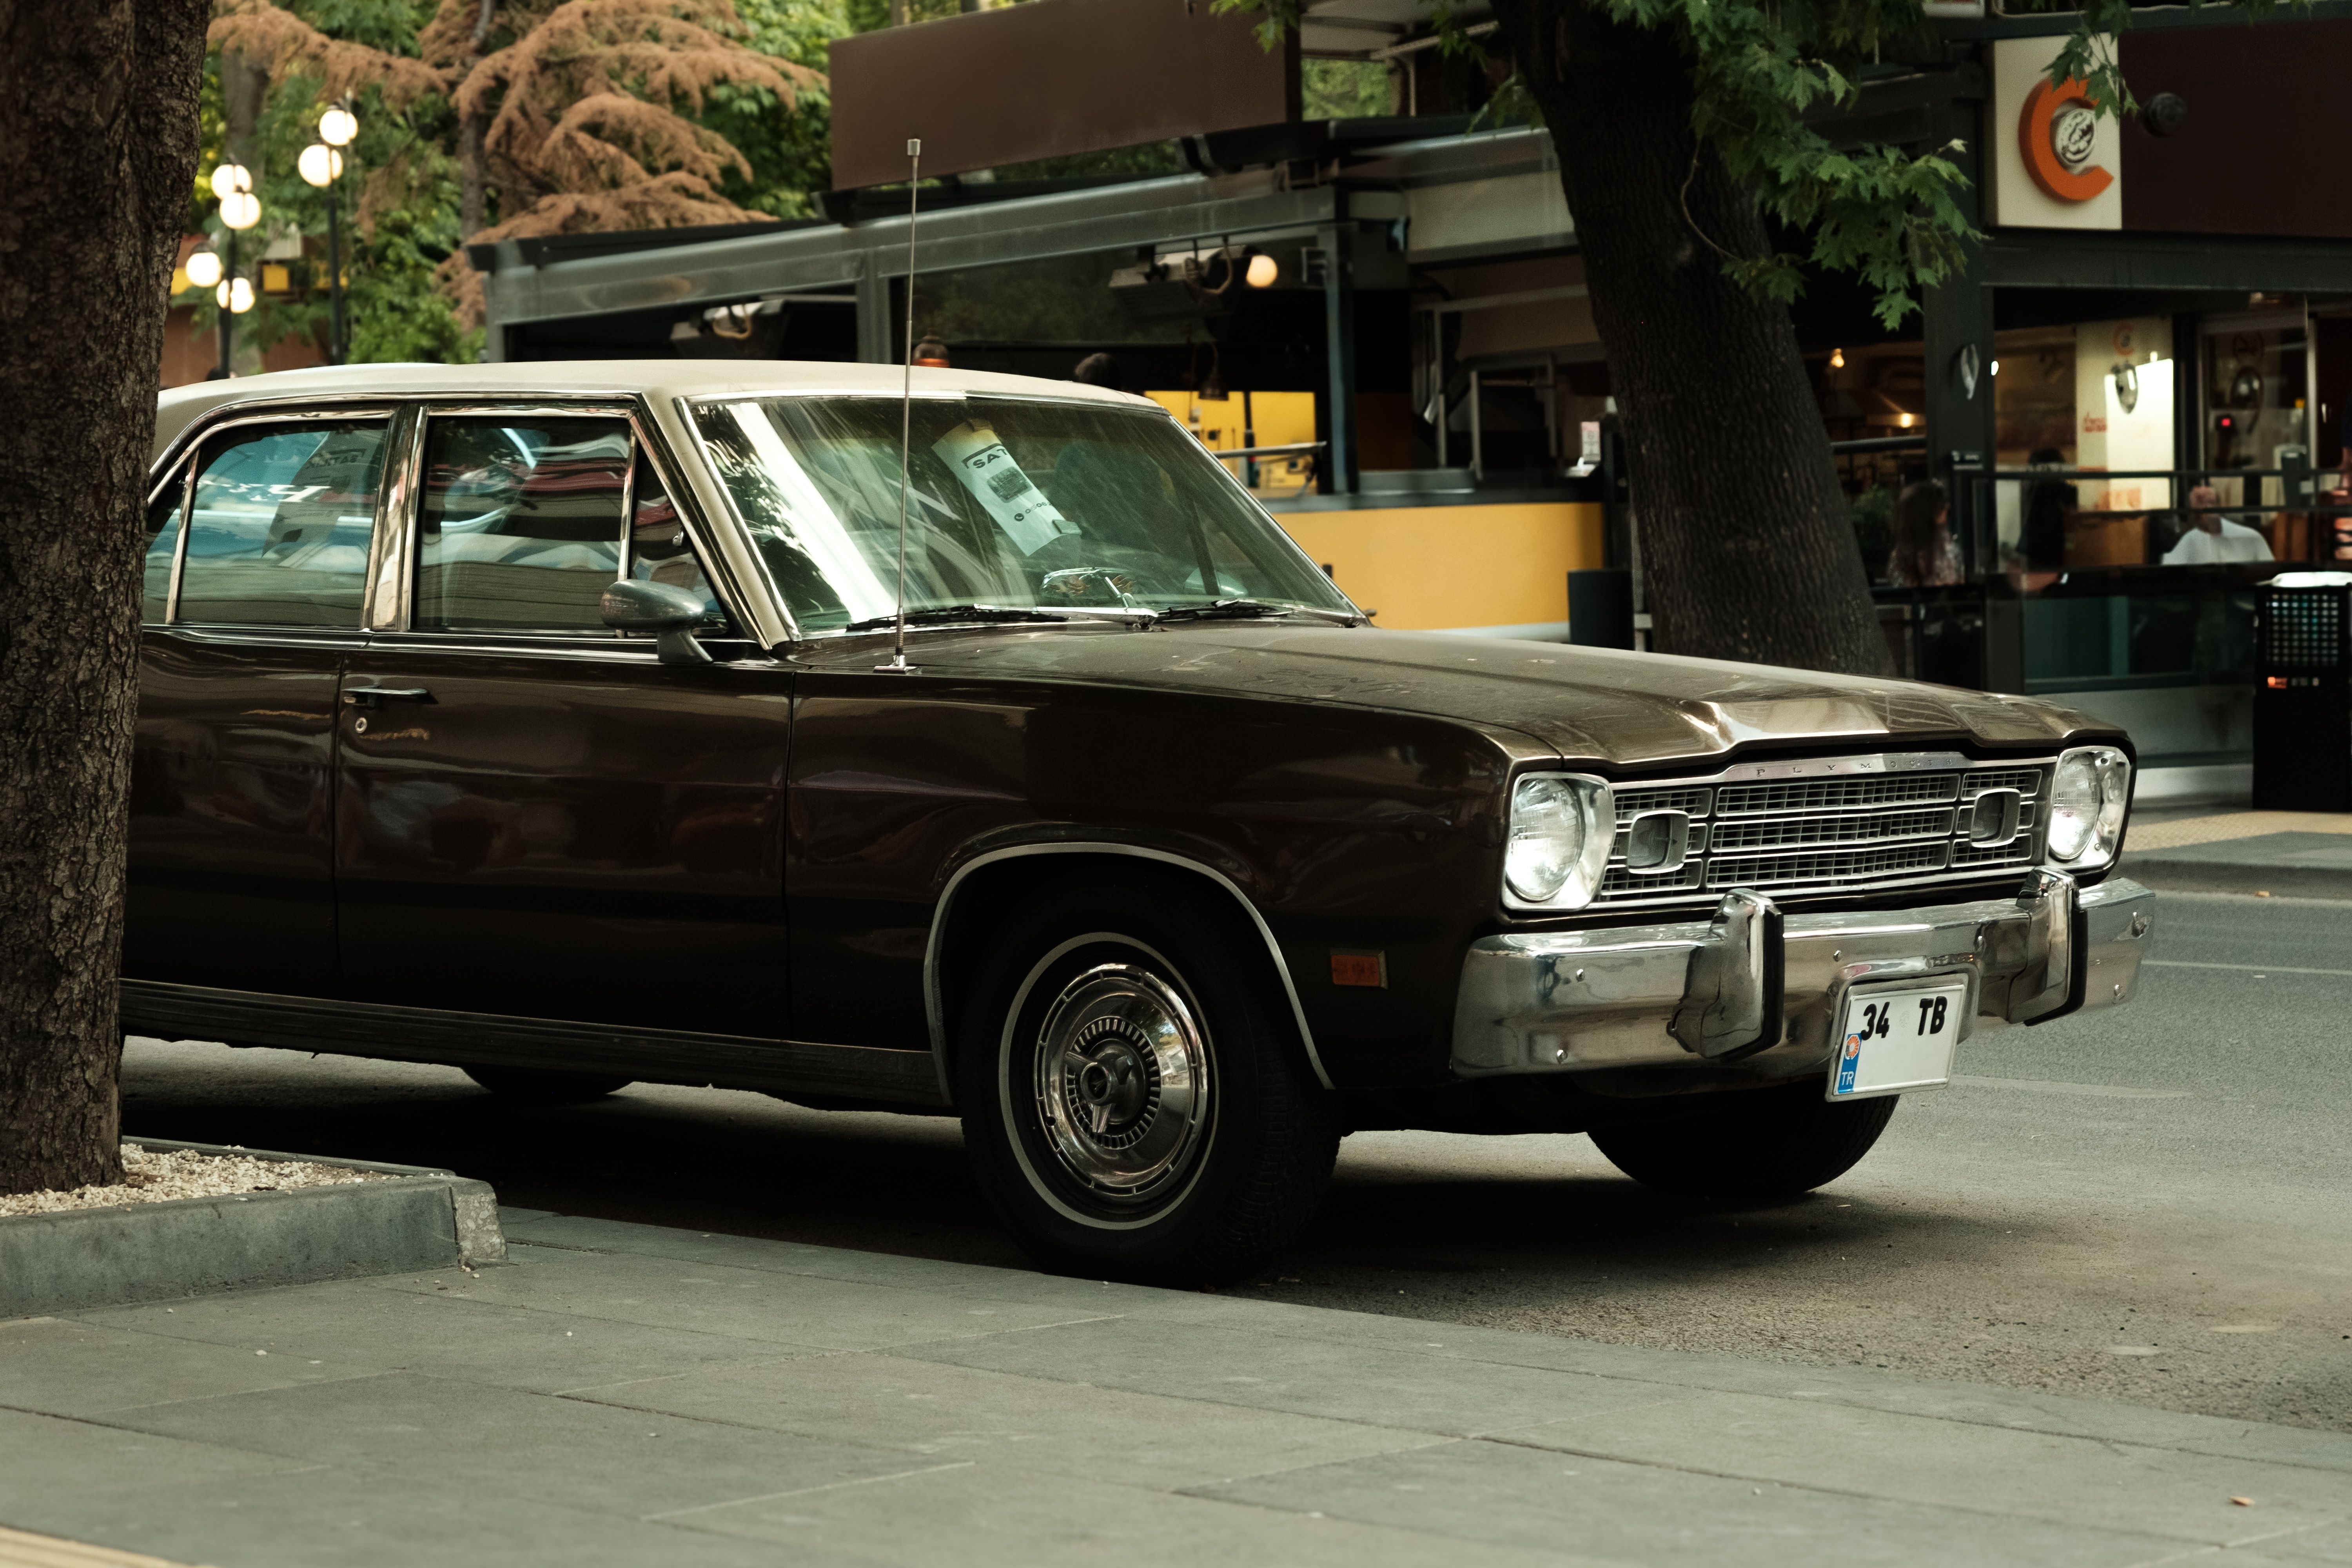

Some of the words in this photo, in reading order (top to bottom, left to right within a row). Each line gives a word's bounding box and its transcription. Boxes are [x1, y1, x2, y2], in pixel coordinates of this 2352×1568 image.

[2020, 73, 2114, 201] C
[973, 448, 1007, 468] SAT
[1861, 1001, 1890, 1041] 34
[1918, 996, 1948, 1036] TB
[1841, 1071, 1854, 1086] TR
